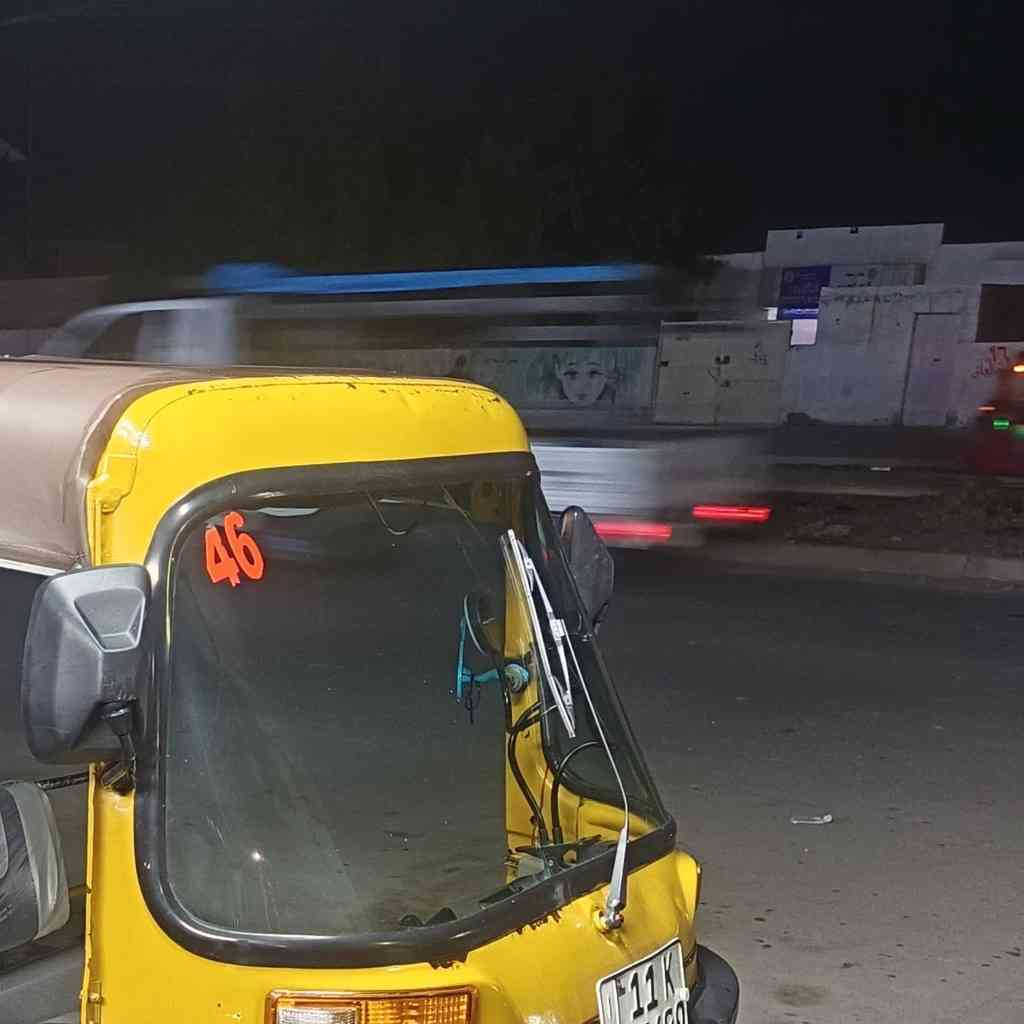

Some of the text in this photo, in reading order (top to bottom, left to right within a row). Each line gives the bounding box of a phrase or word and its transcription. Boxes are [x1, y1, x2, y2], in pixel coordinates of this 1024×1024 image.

[205, 511, 264, 587] 46
[630, 951, 676, 1020] 11 K
